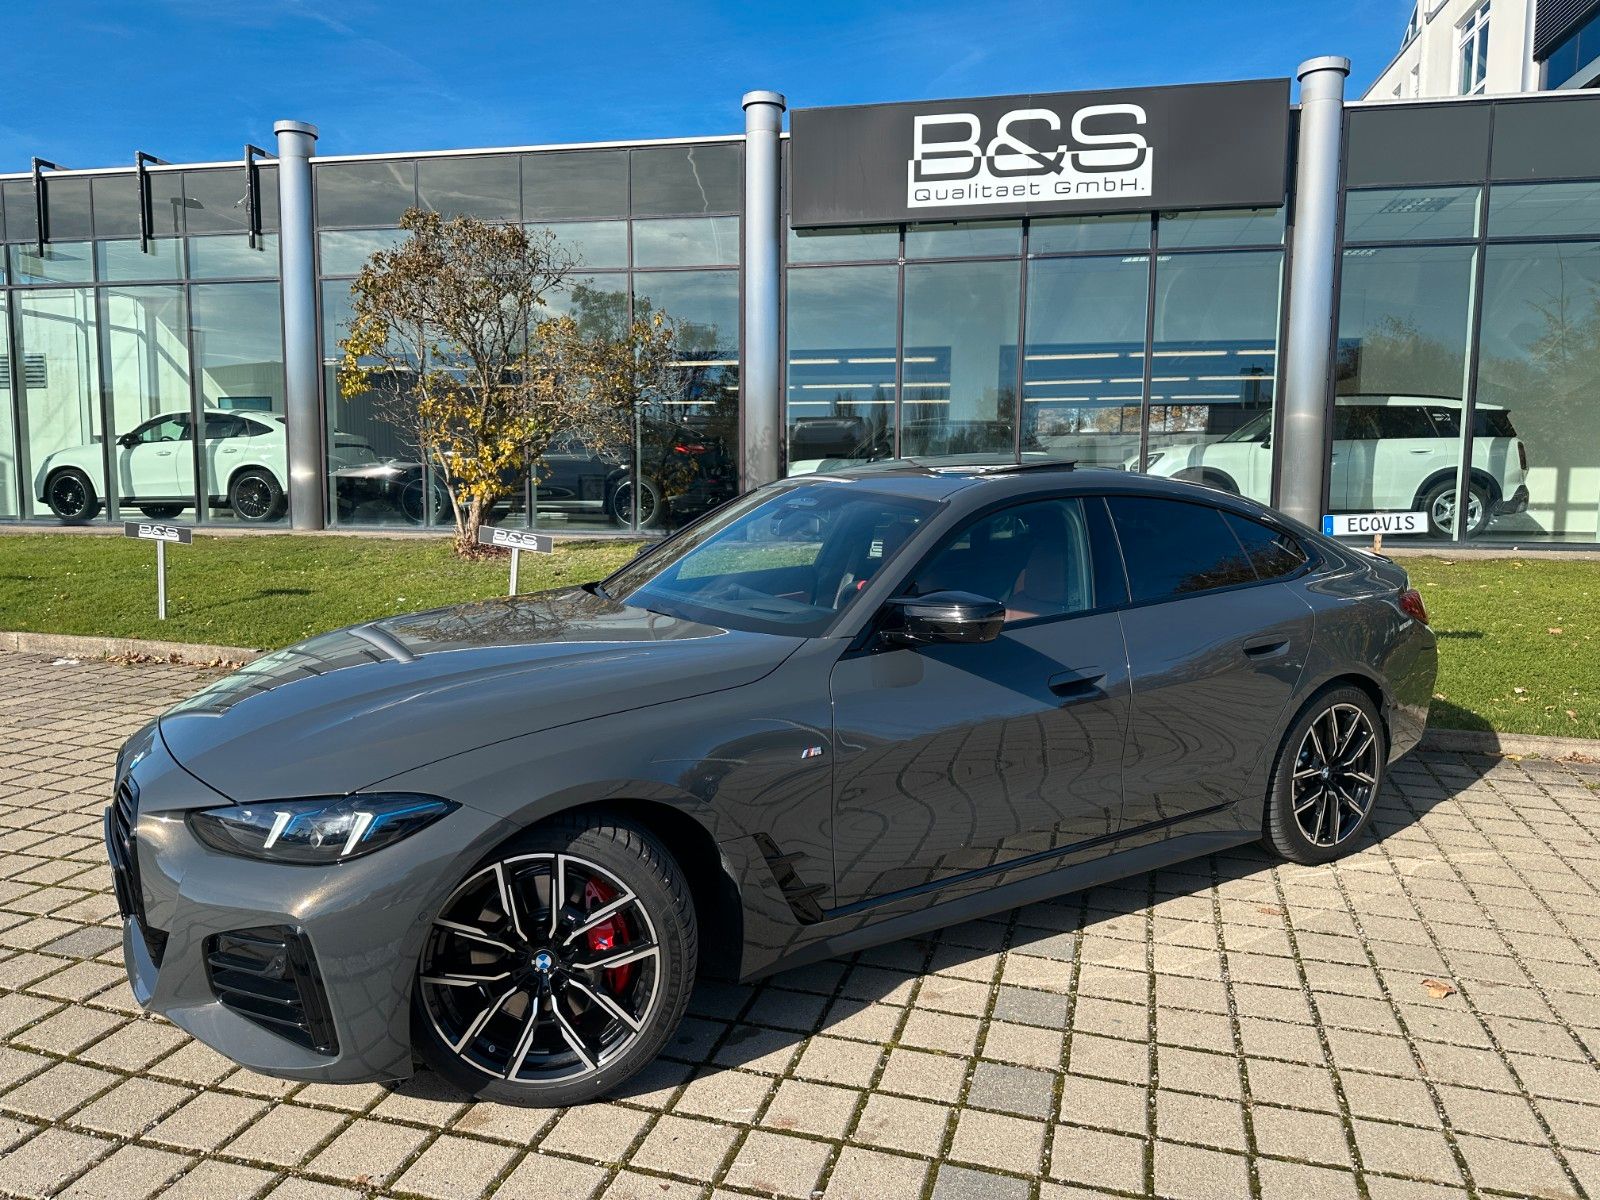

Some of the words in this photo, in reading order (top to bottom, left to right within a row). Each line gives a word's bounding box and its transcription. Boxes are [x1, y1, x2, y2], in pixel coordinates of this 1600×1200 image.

[913, 103, 1148, 183] B&S
[913, 183, 1040, 202] Qualitaet
[1053, 177, 1145, 195] GmbH.
[139, 525, 178, 538] B&S
[1347, 515, 1415, 532] ECOVIS
[494, 529, 537, 546] B&S
